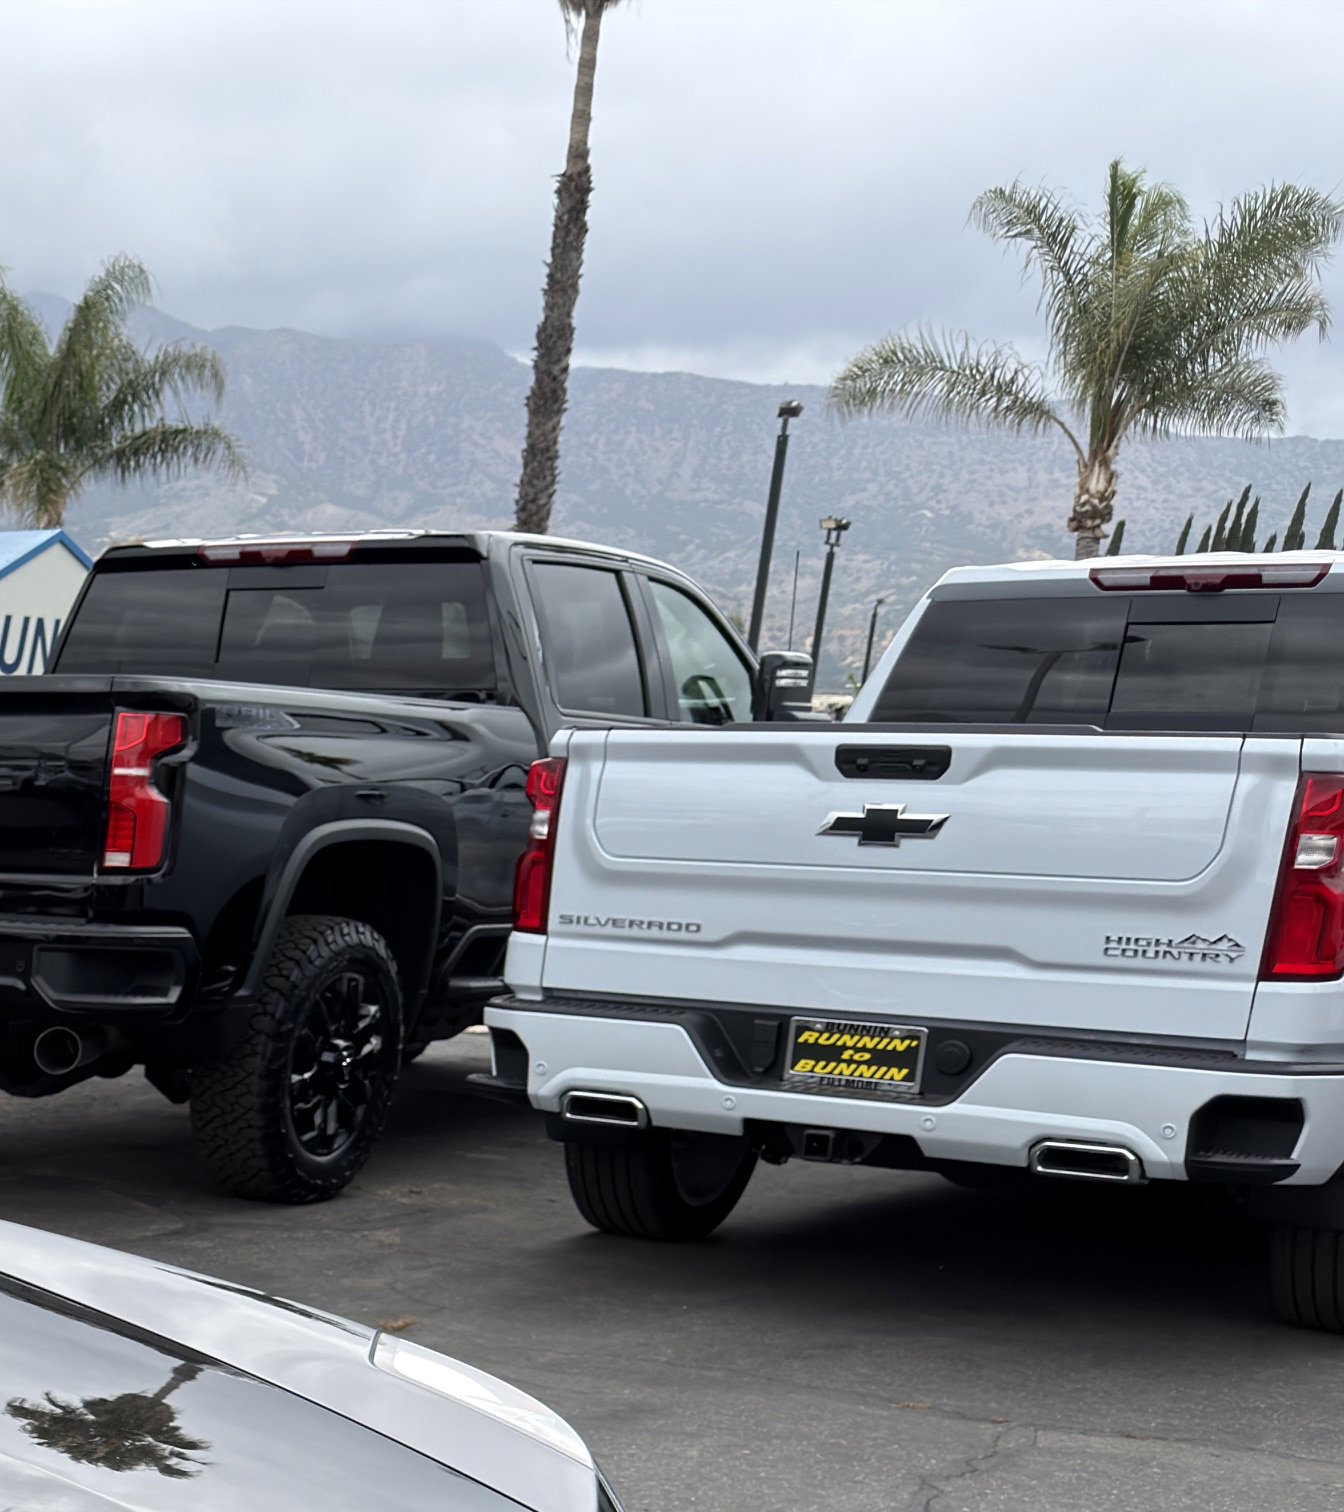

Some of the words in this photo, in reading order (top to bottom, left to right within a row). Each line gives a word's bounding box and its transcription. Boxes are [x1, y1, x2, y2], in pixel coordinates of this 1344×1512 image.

[558, 914, 702, 933] SILVERADO
[1104, 935, 1175, 948] HIGH
[1102, 947, 1244, 964] COUNTRY
[797, 1030, 919, 1052] RUNNIN'
[840, 1049, 872, 1062] to
[792, 1058, 910, 1081] BUNNIN
